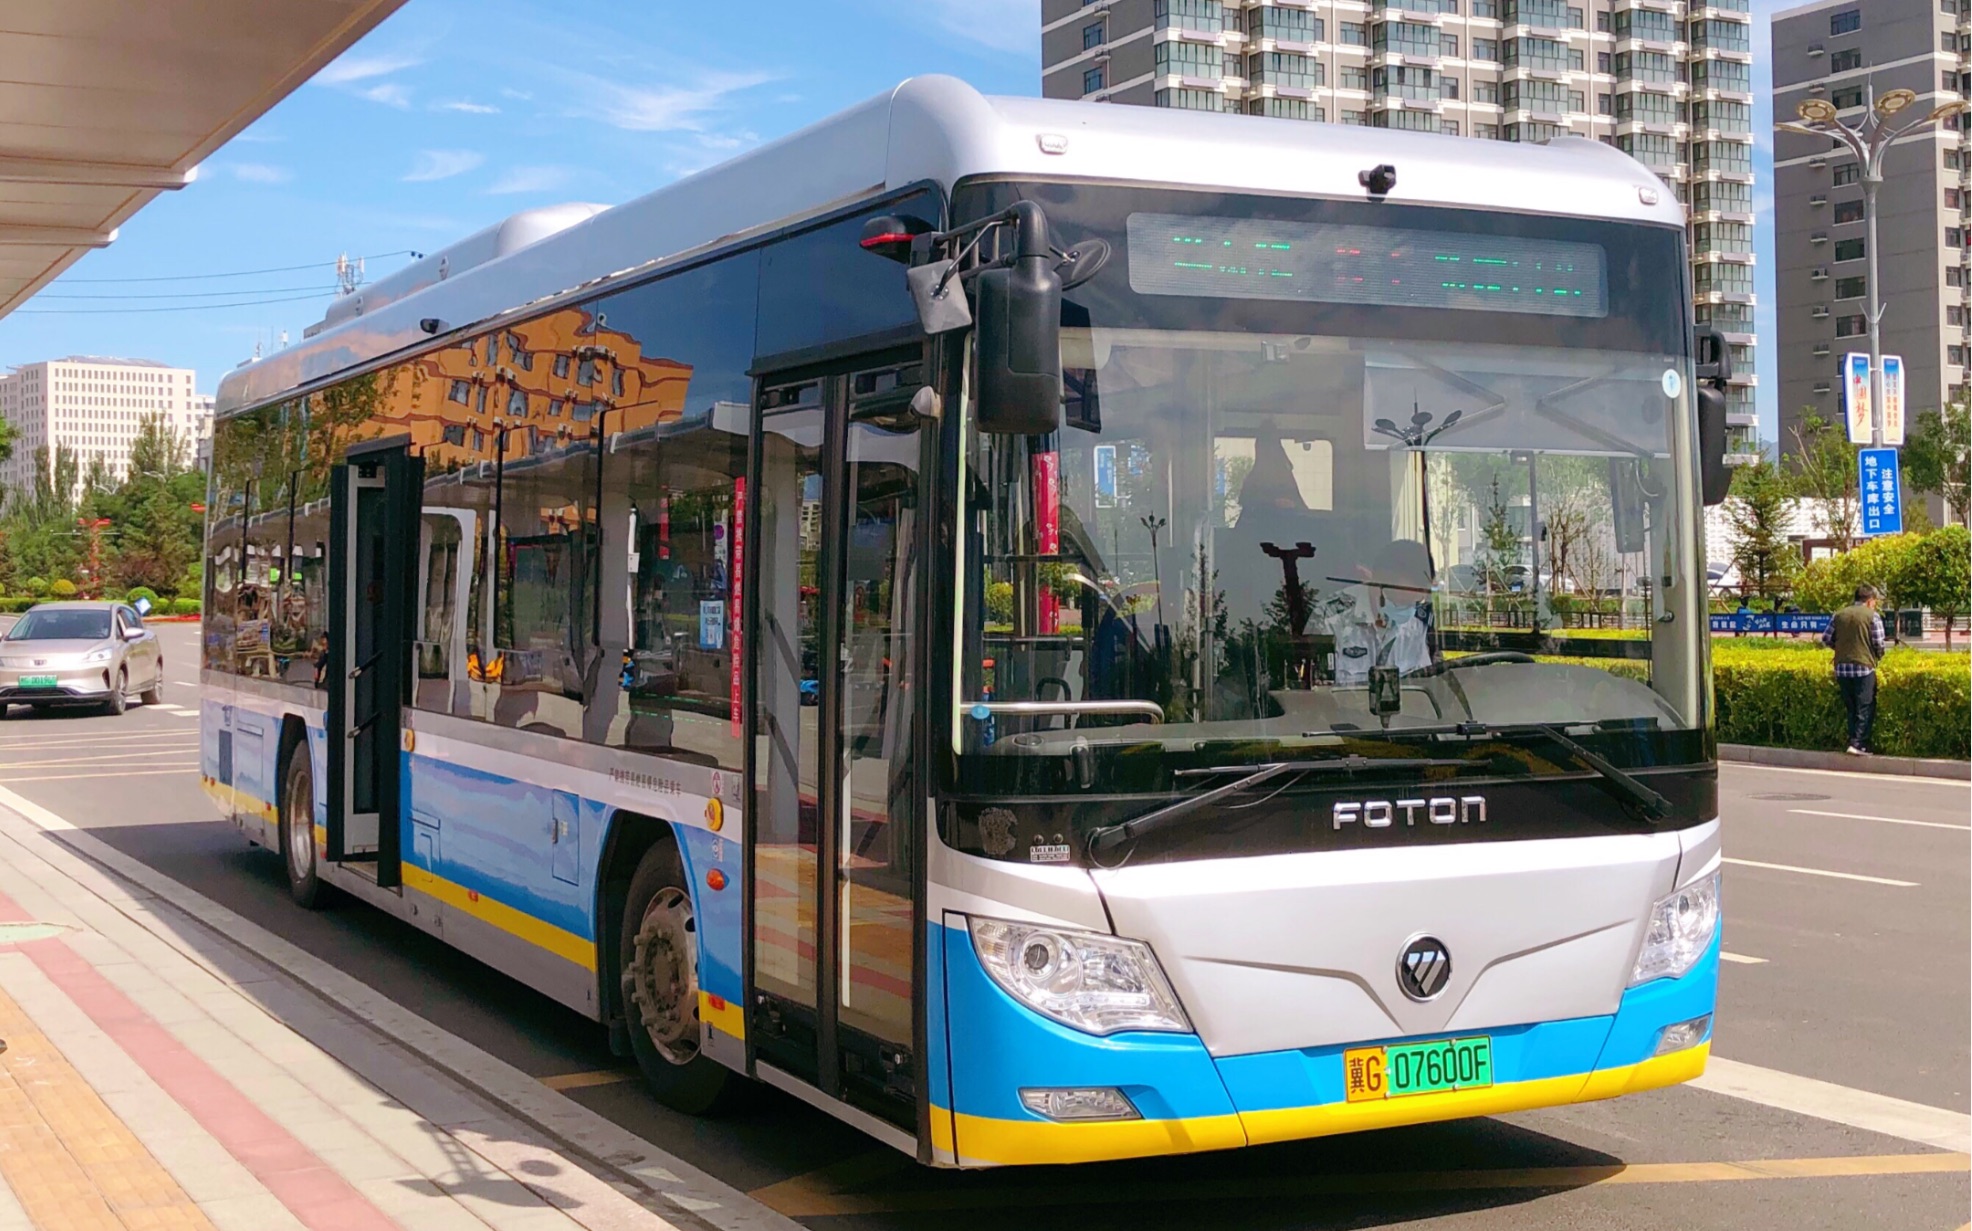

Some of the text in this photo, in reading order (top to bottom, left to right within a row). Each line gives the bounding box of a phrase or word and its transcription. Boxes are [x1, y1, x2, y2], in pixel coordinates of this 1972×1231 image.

[1853, 372, 1868, 427] 中国梦
[1864, 455, 1881, 529] 地下车库出口
[1881, 467, 1895, 515] 注意安全
[1332, 795, 1487, 830] FOTON
[1394, 1043, 1488, 1090] 07600F
